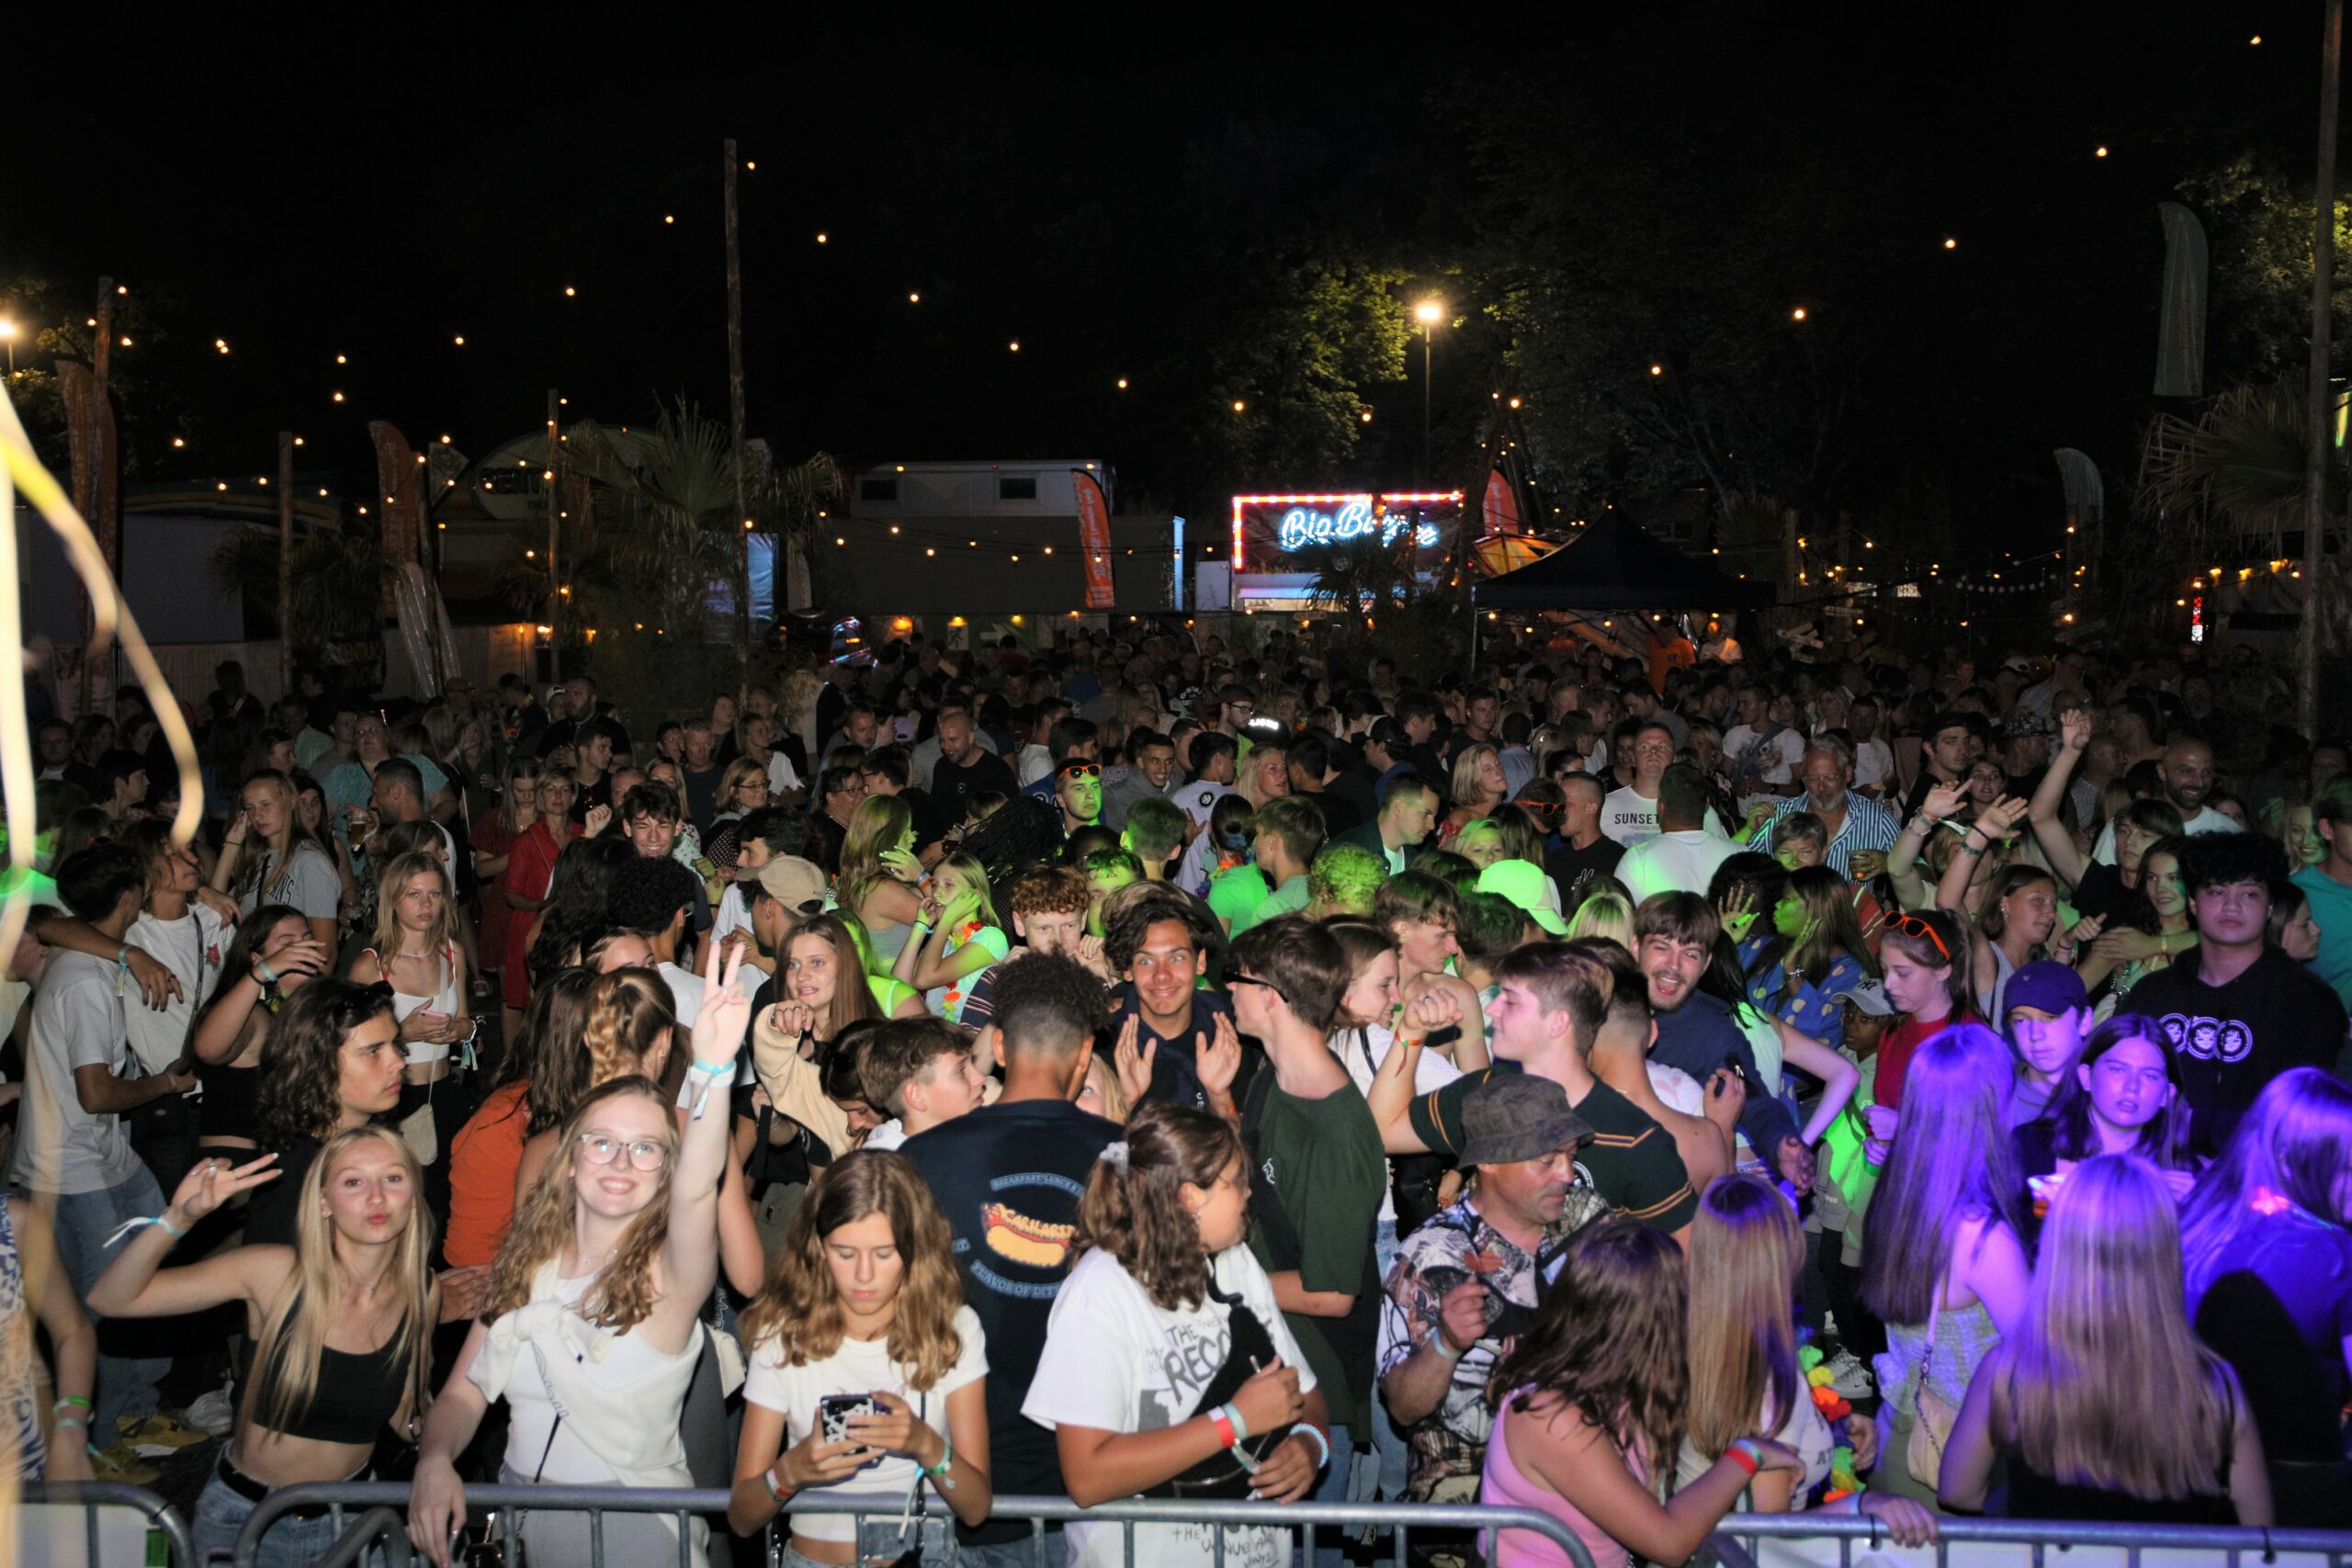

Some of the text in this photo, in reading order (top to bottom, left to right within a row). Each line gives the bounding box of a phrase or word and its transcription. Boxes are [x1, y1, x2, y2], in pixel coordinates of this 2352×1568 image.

[1614, 813, 1659, 825] SUNSET
[1013, 1282, 1031, 1297] OF
[1166, 1324, 1199, 1347] THE
[1164, 1328, 1232, 1407] RECO
[1201, 1538, 1250, 1556] VNUE
